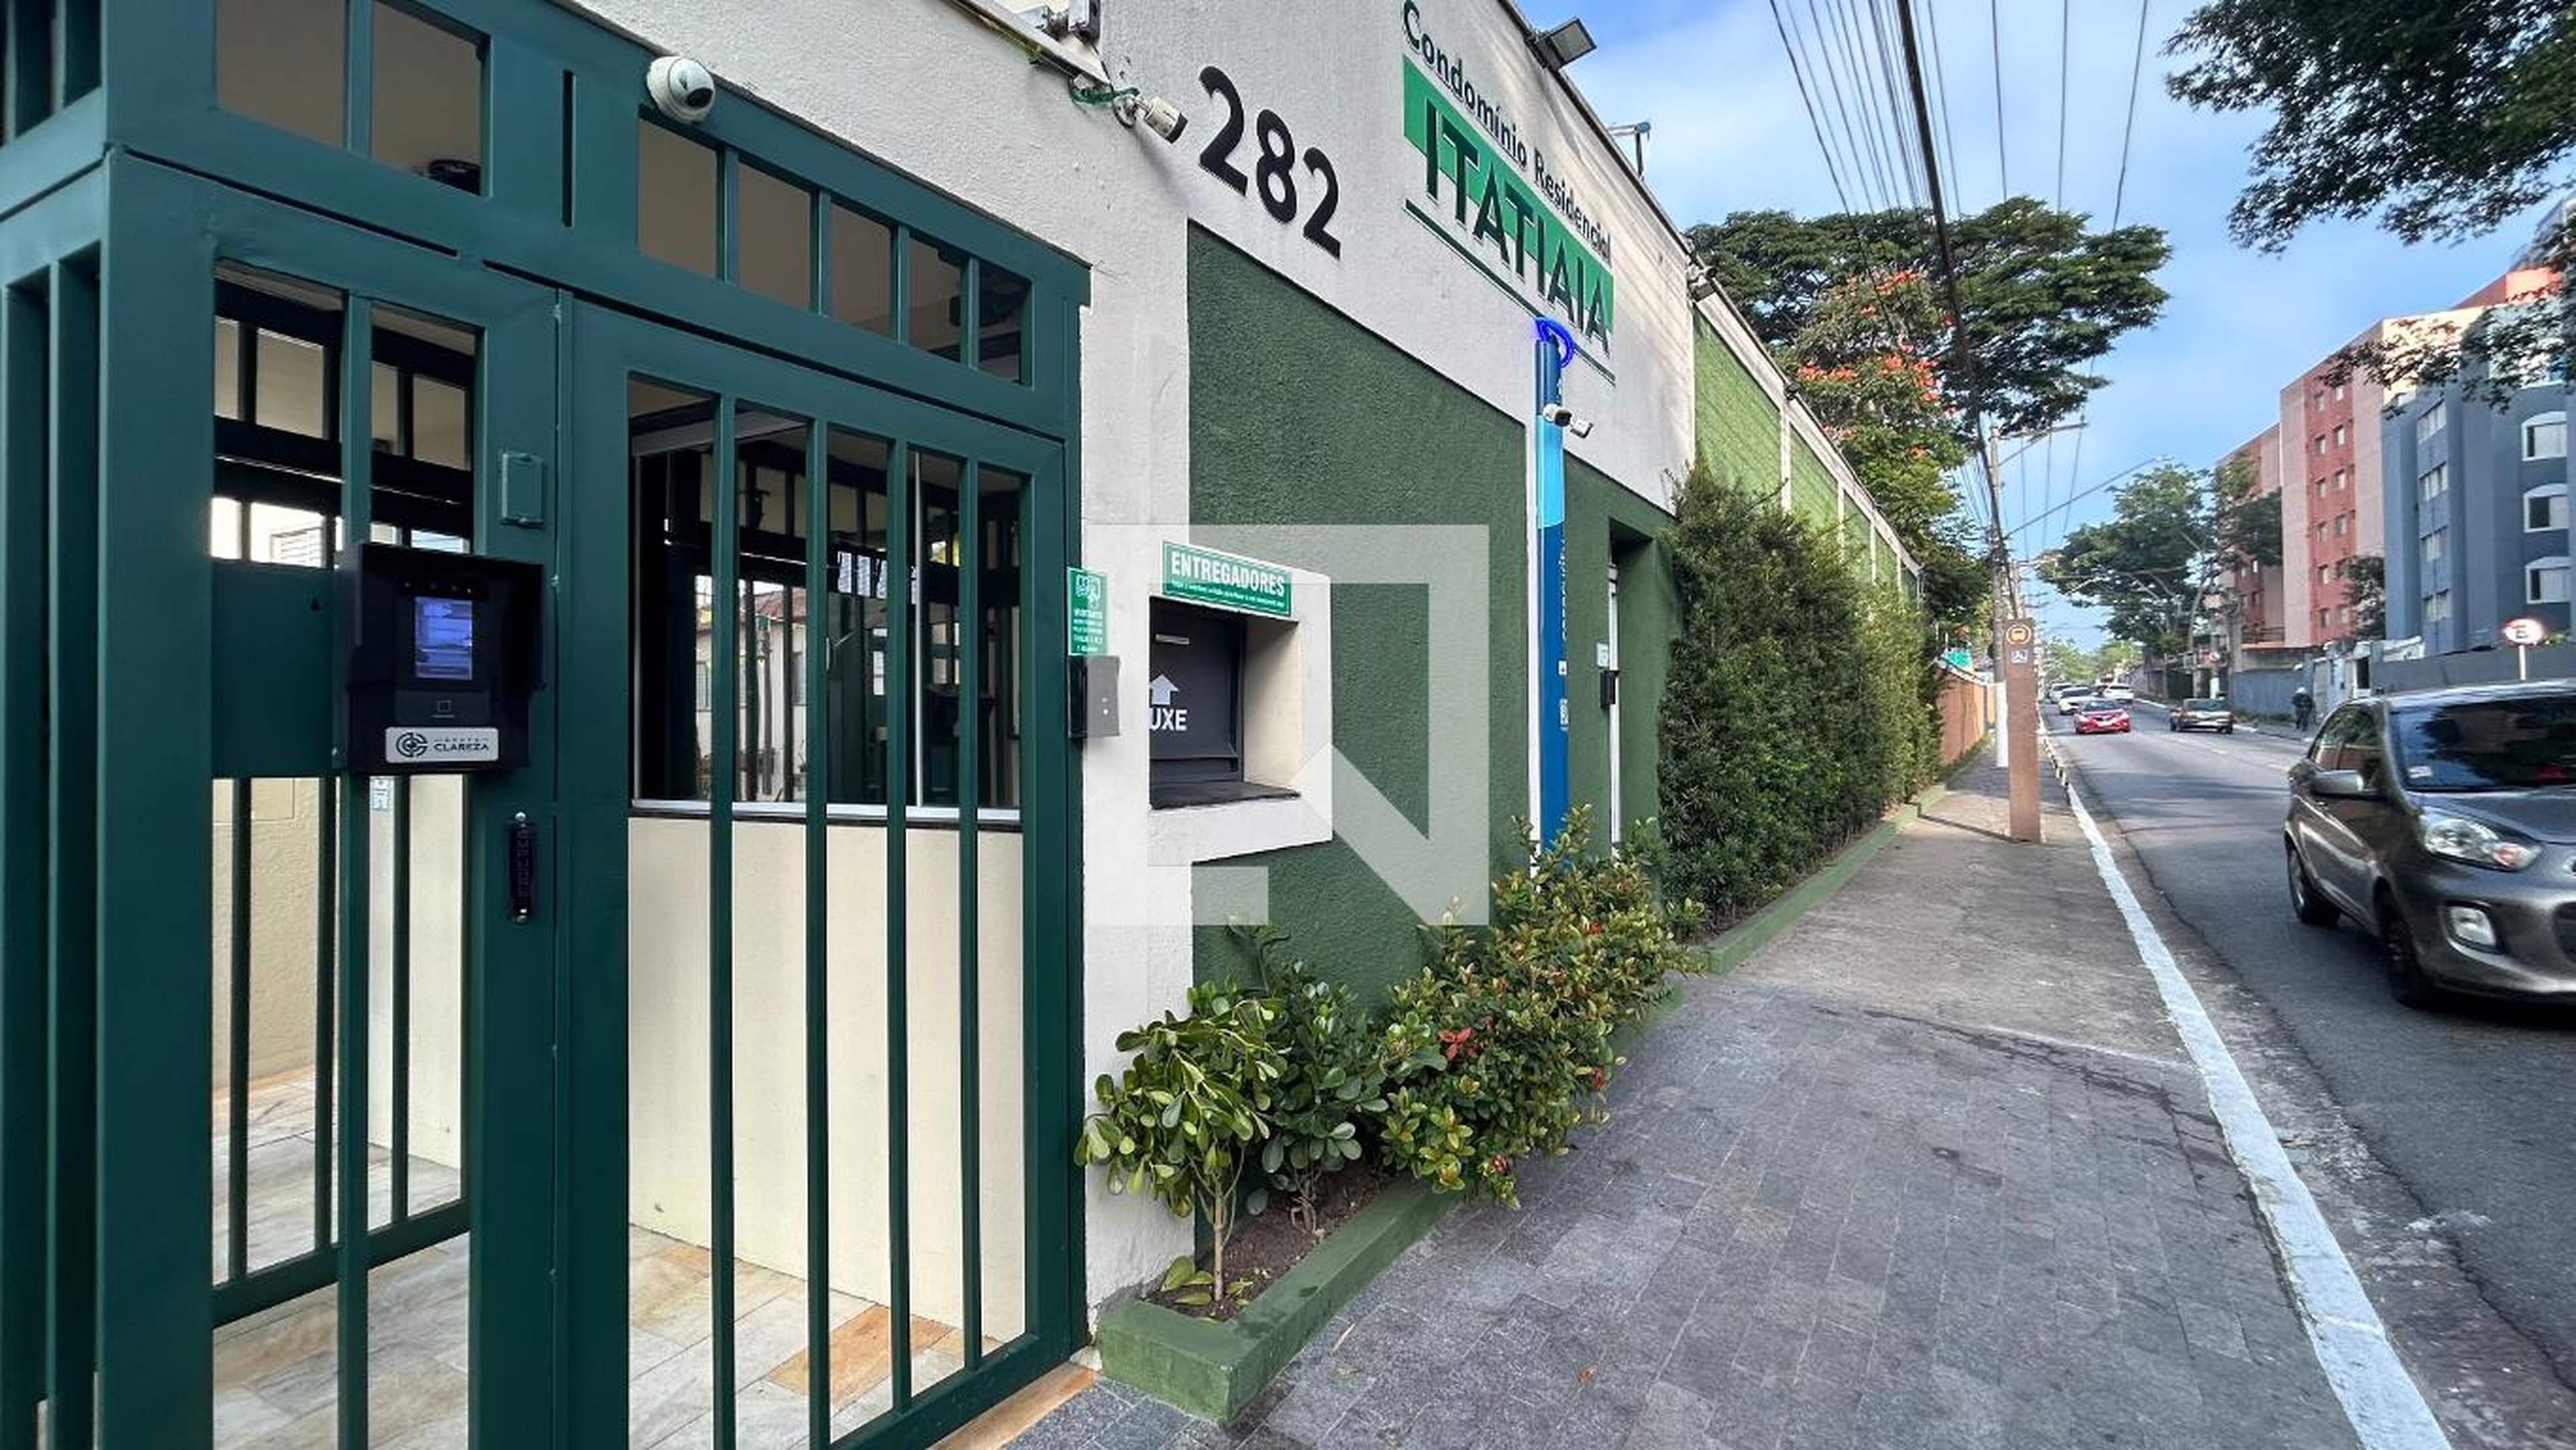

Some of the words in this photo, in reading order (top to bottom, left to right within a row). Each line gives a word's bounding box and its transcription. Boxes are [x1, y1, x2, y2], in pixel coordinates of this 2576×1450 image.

[1199, 66, 1341, 258] 282
[1404, 1, 1527, 166] Condomínio
[1534, 147, 1611, 259] Residencial
[1426, 98, 1609, 352] ITATIAIA
[1171, 551, 1285, 597] ENTREGADORES
[434, 743, 489, 752] CLAREZA
